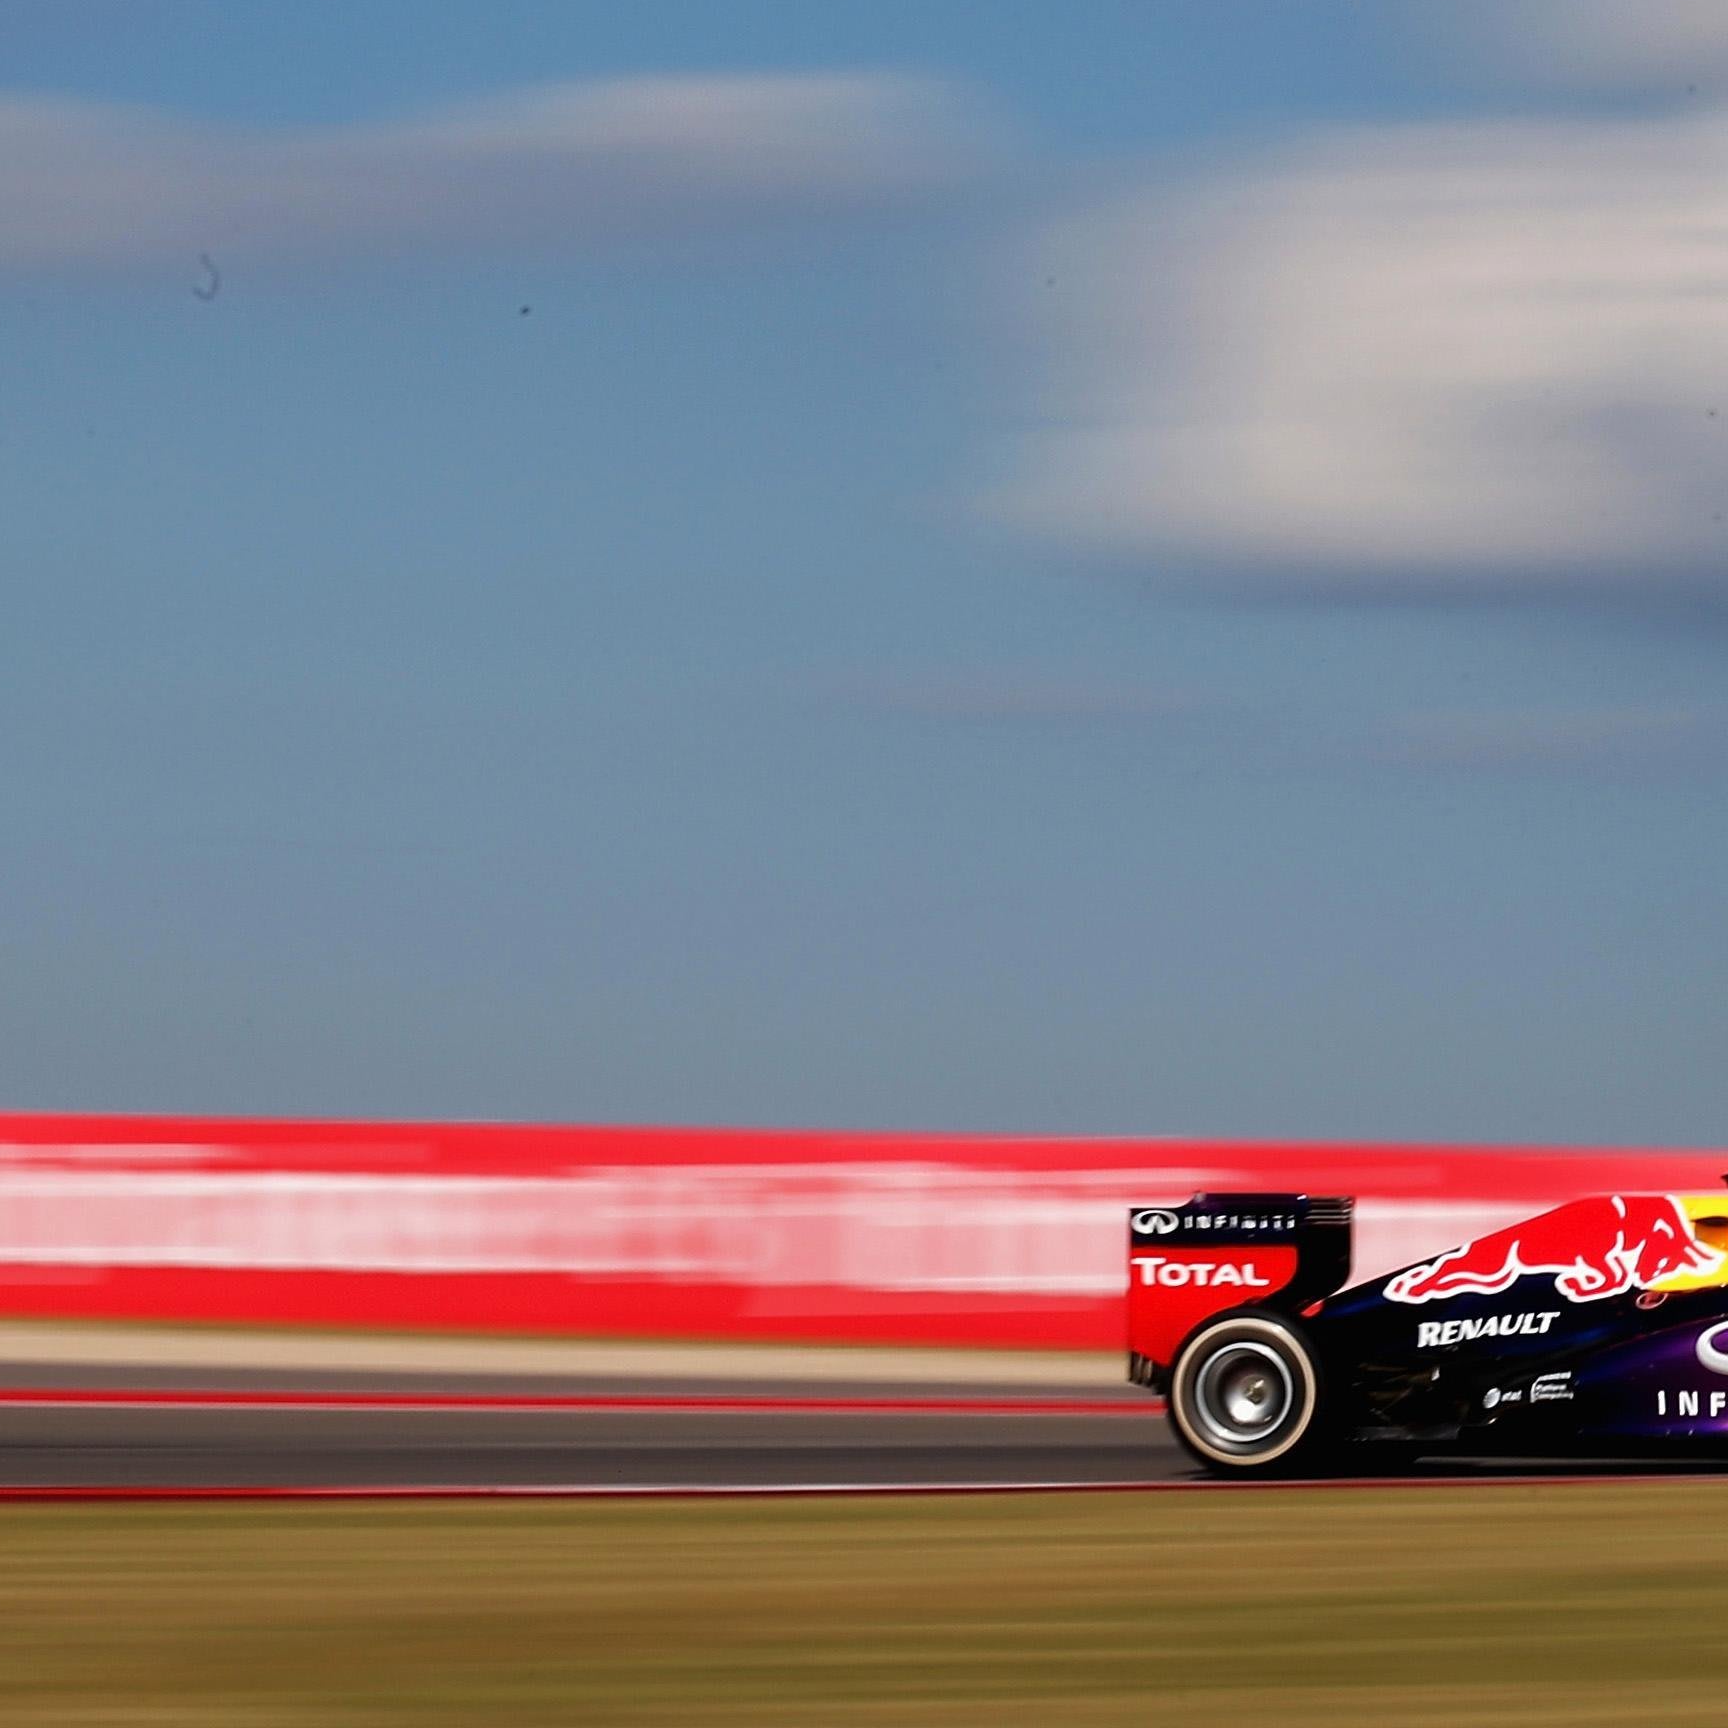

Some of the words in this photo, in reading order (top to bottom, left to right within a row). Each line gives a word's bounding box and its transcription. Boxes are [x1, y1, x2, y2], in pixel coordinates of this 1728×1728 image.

[1183, 1214, 1296, 1230] INFINITI
[1130, 1257, 1270, 1287] TOTAL
[1417, 1311, 1562, 1348] RENAULT
